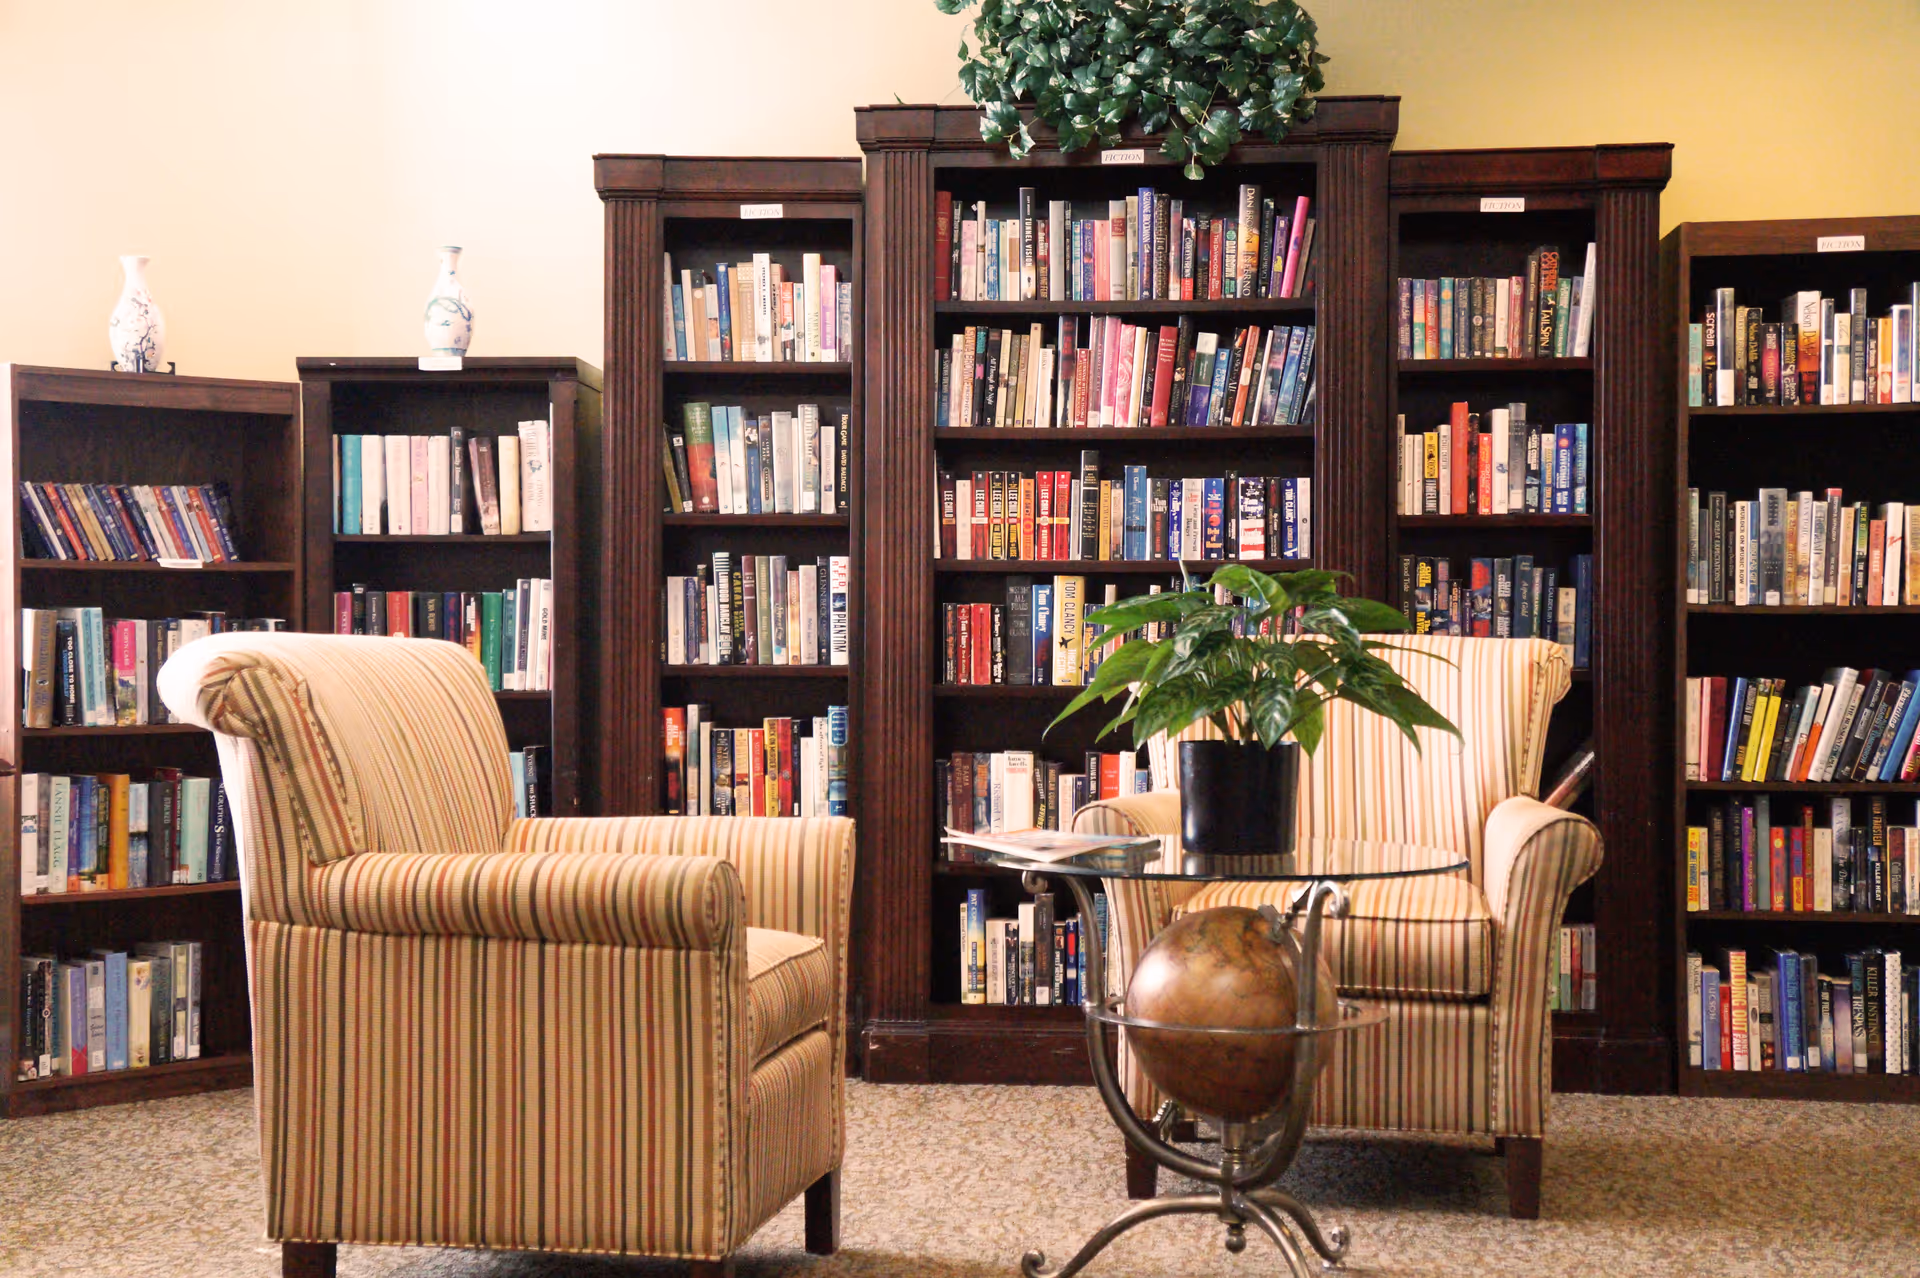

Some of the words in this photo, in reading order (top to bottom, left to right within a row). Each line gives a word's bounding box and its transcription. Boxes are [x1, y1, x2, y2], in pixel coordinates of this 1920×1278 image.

[1104, 153, 1142, 162] FICTION
[1143, 192, 1151, 213] SUZANNE
[1246, 188, 1255, 207] DAN
[1483, 199, 1523, 211] FICTION
[743, 206, 781, 217] FICTION
[1025, 217, 1033, 243] TUNNEL
[1142, 214, 1151, 243] BROCKMANN
[1245, 210, 1254, 243] BROWN
[1025, 244, 1033, 267] VISION
[1226, 240, 1236, 253] DAN
[1820, 239, 1863, 251] FICTION
[1225, 254, 1235, 277] BROWN
[1242, 252, 1255, 296] INFERNO
[1803, 301, 1816, 328] Nelson
[965, 329, 975, 352] SYLVIA
[1706, 312, 1716, 347] scream
[1749, 322, 1758, 340] Nelson
[1748, 341, 1759, 362] DeMille
[1801, 330, 1817, 361] DeMille
[988, 365, 996, 383] Through
[841, 414, 849, 429] HOUR
[1559, 449, 1567, 464] CLIVE
[1559, 465, 1567, 489] CUSSLER
[944, 490, 953, 501] LEE
[976, 490, 985, 500] LEE
[993, 490, 1001, 500] LEE
[1009, 490, 1017, 500] LEE
[1041, 489, 1049, 499] LEE
[1285, 488, 1294, 501] TOM
[1425, 480, 1437, 512] TIMELINE
[944, 502, 953, 517] CHILD
[975, 501, 985, 516] CHILD
[993, 501, 1001, 517] CHILD
[1008, 501, 1017, 517] CHILD
[1285, 502, 1293, 523] CLANCY
[1739, 536, 1745, 545] ON
[819, 568, 828, 596] GLENN
[838, 564, 847, 588] TED
[1418, 562, 1426, 587] CUSSLER
[1497, 574, 1505, 597] CUSSLER
[718, 572, 729, 603] LINWOOD
[732, 572, 742, 607] CABAL
[1038, 589, 1050, 605] Tom
[1065, 581, 1075, 599] TOM
[1521, 581, 1529, 599] Aspen
[427, 599, 435, 612] NORA
[820, 598, 828, 618] BECK
[1520, 601, 1529, 617] Gold
[720, 604, 730, 634] BARCLAY
[1035, 606, 1049, 632] Clancy
[1064, 602, 1075, 634] CLANCY
[832, 613, 847, 653] PHANTOM
[1067, 649, 1077, 673] THREAT
[1876, 702, 1888, 728] AGAINST
[1889, 687, 1911, 729] Skywriting
[768, 722, 776, 735] BACK
[1859, 730, 1877, 764] TOMORROW
[962, 765, 970, 787] RAMA
[54, 783, 63, 825] FANNIE
[993, 783, 1002, 813] Richard
[163, 797, 172, 824] STALKED
[213, 825, 225, 833] S
[1872, 816, 1883, 846] FAIRSTEIN
[53, 830, 62, 868] FLAGG
[1838, 854, 1848, 868] The
[1838, 870, 1848, 893] Divide
[1730, 954, 1746, 1006] HOLDING
[1866, 967, 1878, 997] KILLER
[1708, 982, 1716, 1021] TUCSON
[1821, 991, 1830, 1001] JOY
[1732, 1010, 1747, 1033] OUT
[1852, 995, 1864, 1038] TRESPASS
[1868, 1002, 1878, 1045] INSTINCT
